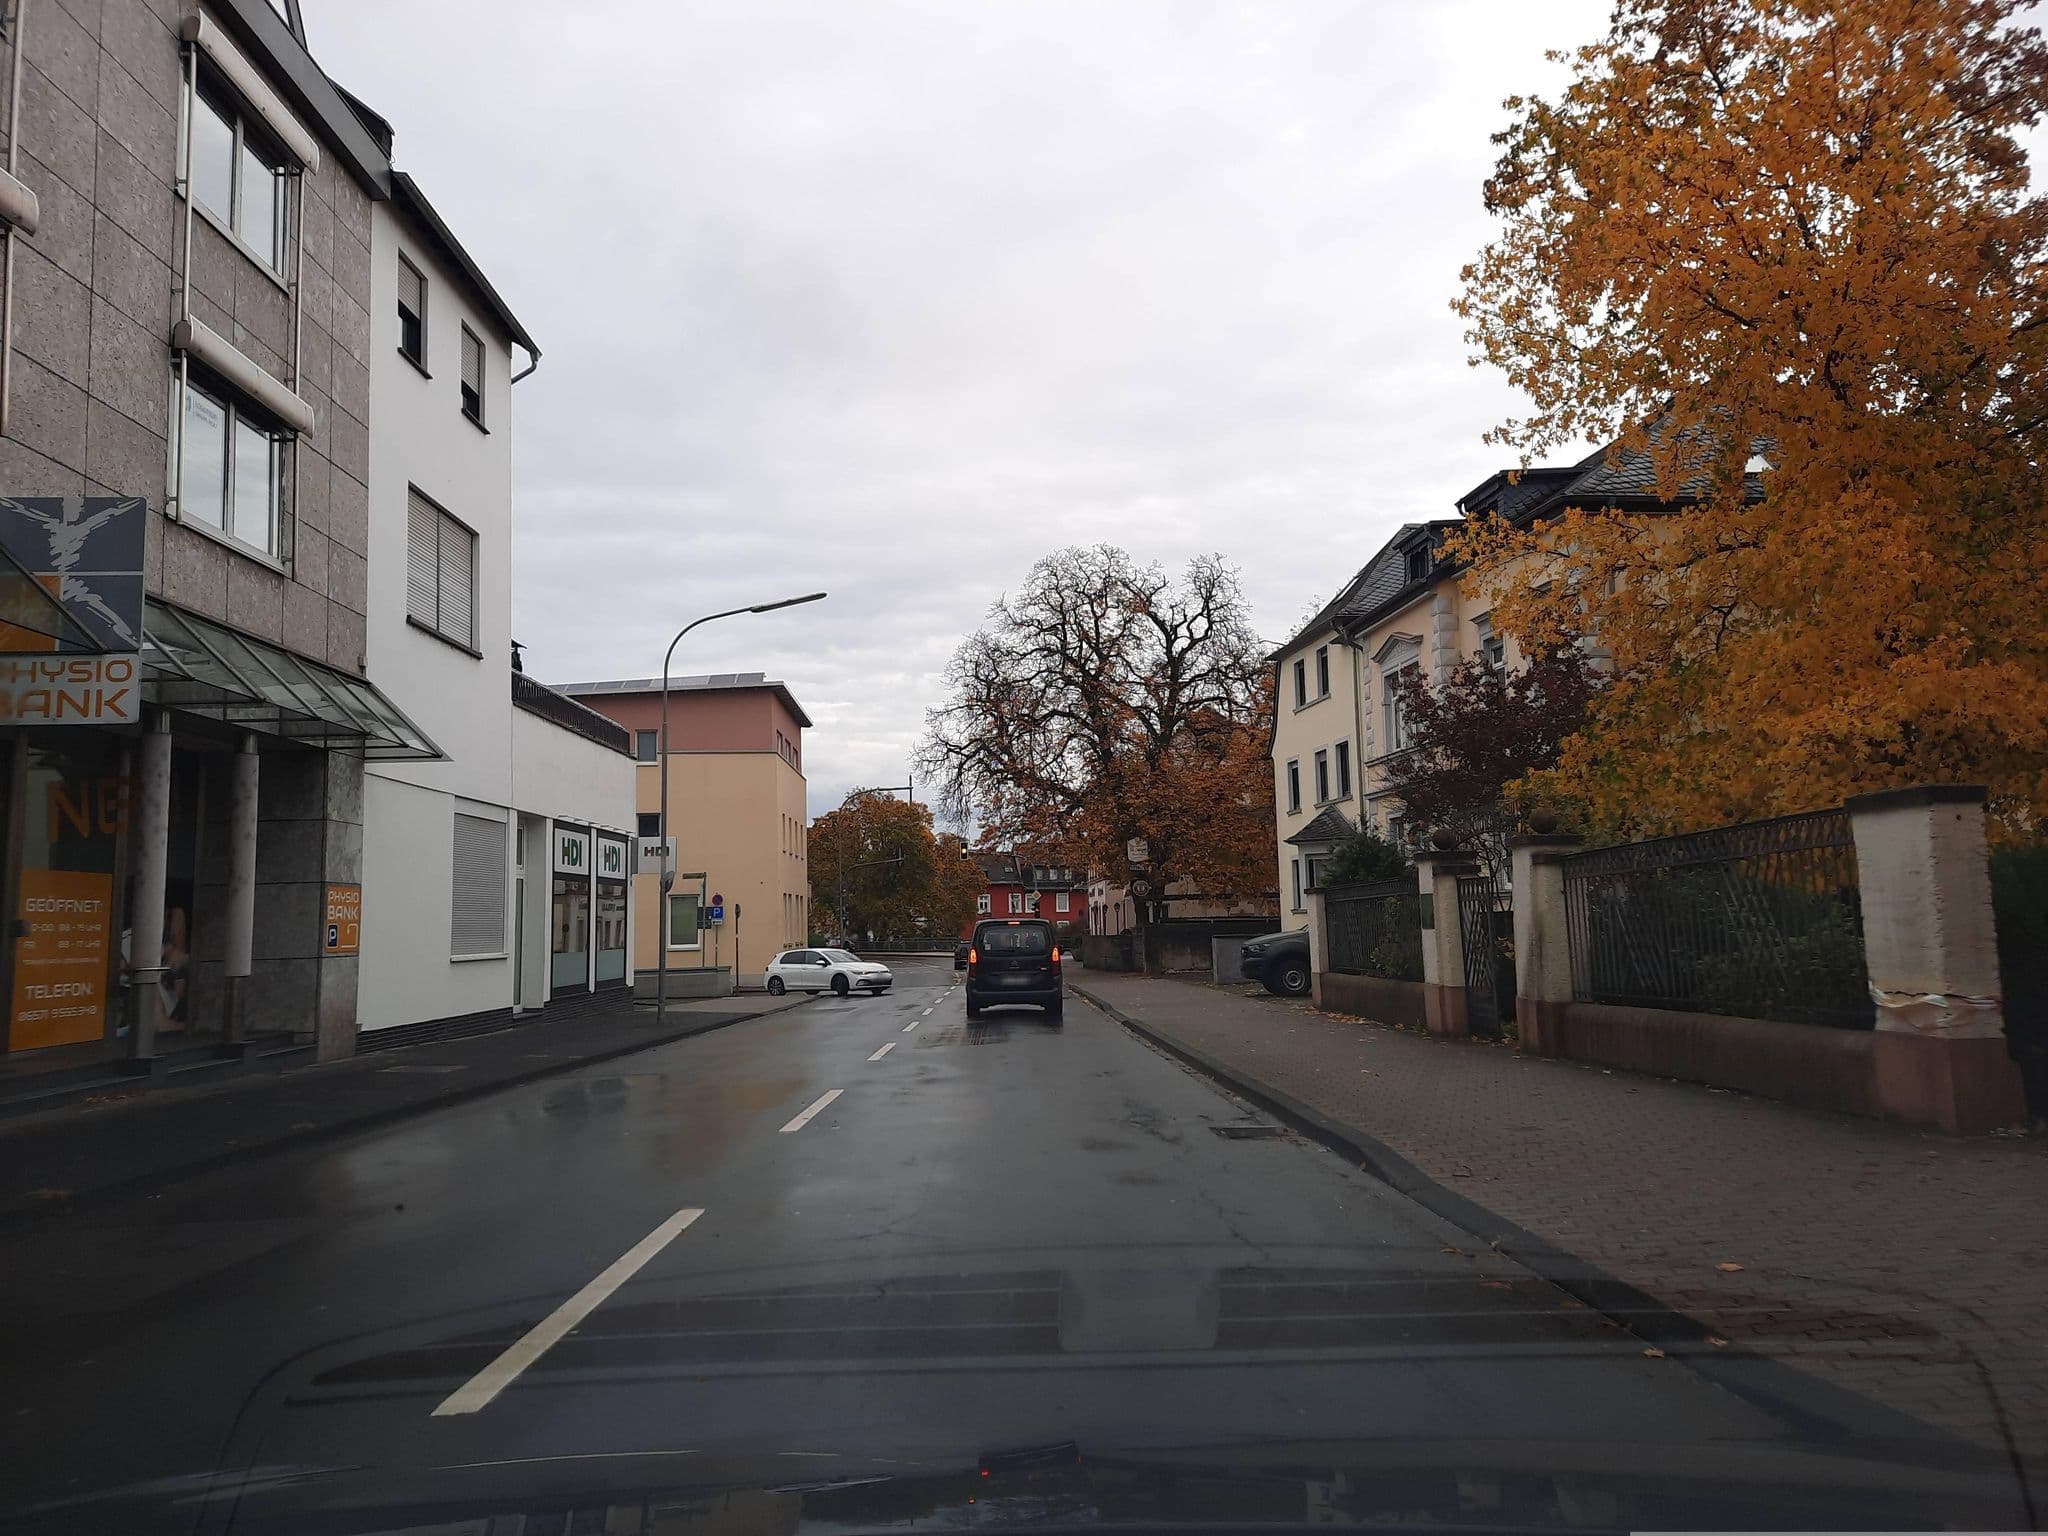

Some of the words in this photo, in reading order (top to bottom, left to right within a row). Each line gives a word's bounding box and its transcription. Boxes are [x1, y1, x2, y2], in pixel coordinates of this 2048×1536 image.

[562, 837, 582, 867] HDI
[603, 844, 620, 873] HDI
[328, 890, 359, 903] PHYSIO
[327, 905, 359, 919] BANK
[713, 907, 721, 917] P
[329, 928, 336, 943] P
